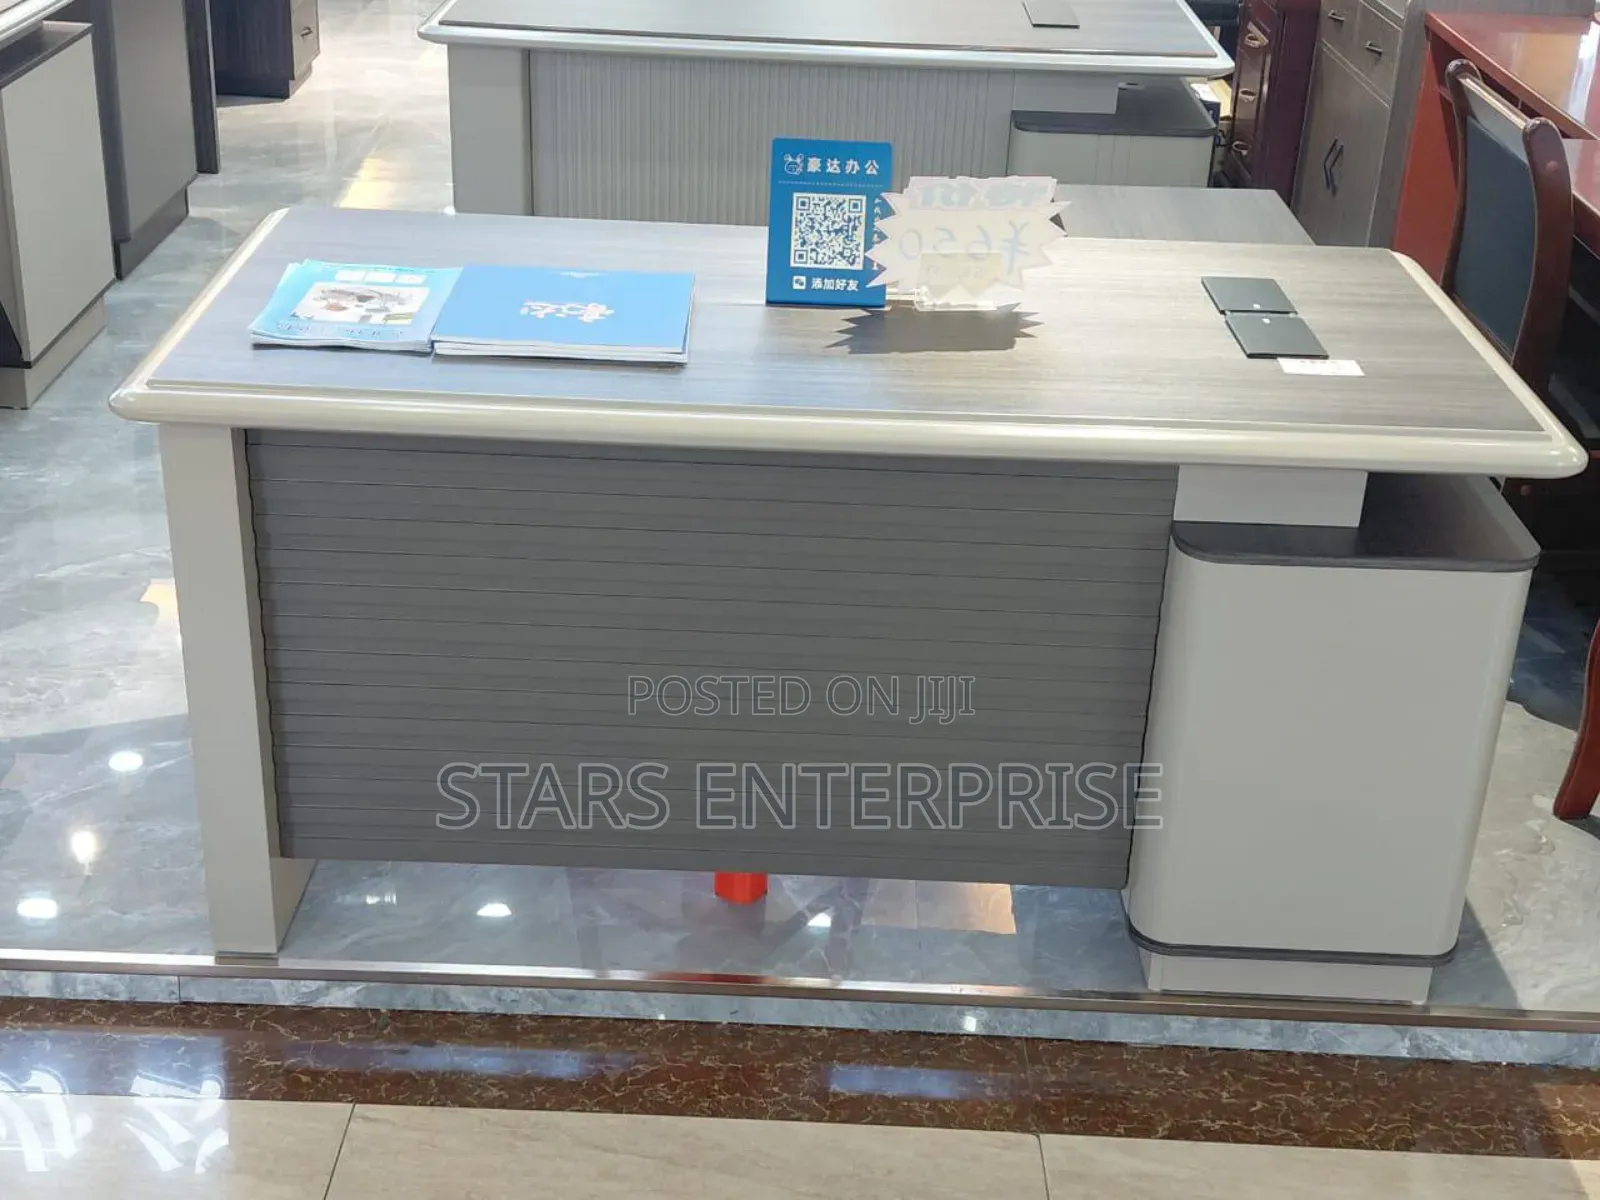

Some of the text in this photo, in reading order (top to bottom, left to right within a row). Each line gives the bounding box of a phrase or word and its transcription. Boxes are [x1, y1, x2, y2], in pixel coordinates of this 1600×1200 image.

[807, 156, 880, 175] 豪达办公
[811, 277, 860, 291] 添加好友
